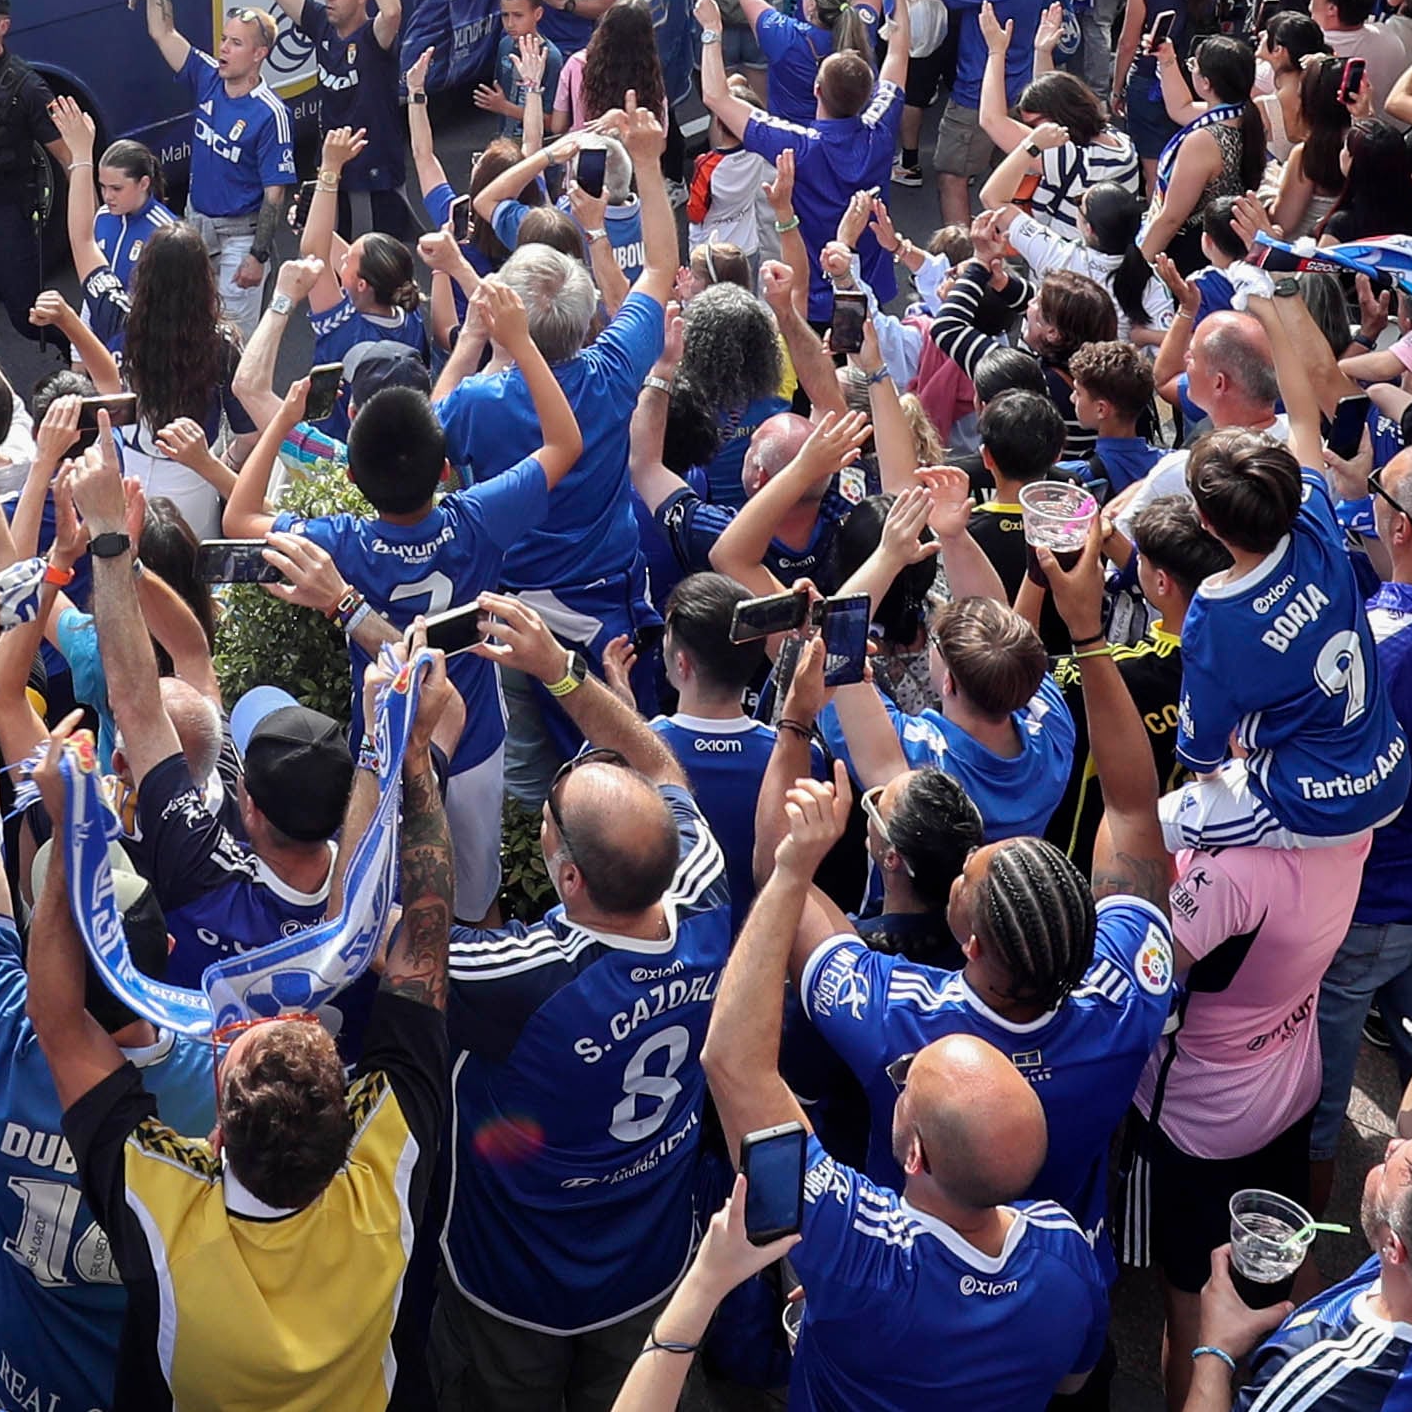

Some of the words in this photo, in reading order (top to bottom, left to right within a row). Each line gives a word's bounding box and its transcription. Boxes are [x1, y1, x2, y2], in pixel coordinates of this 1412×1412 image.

[318, 63, 359, 92] DIGI
[160, 140, 193, 166] Mah
[194, 117, 241, 164] DIGI
[612, 241, 646, 270] BOV
[1252, 574, 1297, 615] exiom
[1260, 583, 1331, 654] BORJA
[1313, 629, 1367, 727] 9
[1143, 703, 1180, 734] CO
[693, 737, 743, 753] exiom
[630, 959, 686, 983] exiom
[608, 965, 728, 1039] CAZORL
[607, 1024, 691, 1143] 8
[959, 1274, 1019, 1296] exiom
